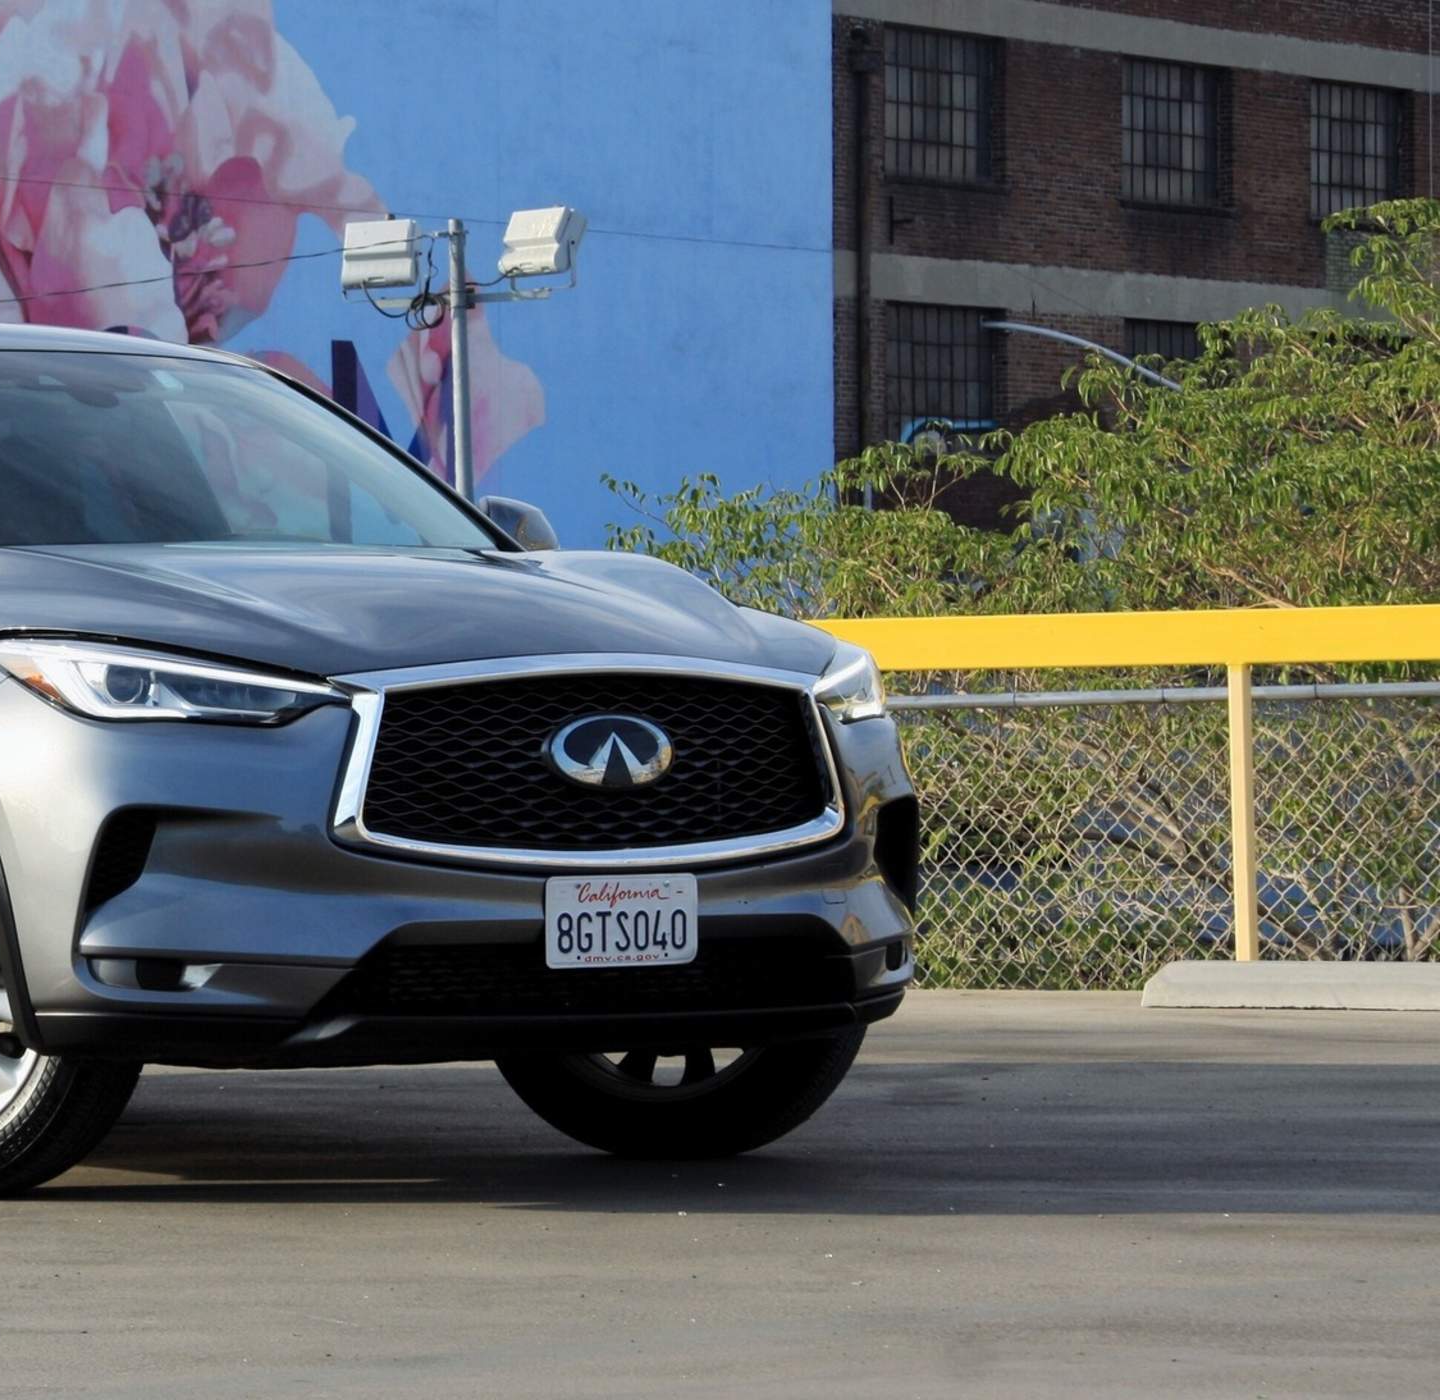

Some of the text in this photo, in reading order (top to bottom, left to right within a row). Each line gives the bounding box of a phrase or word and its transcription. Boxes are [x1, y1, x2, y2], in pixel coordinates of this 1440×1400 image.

[577, 882, 670, 908] California
[558, 909, 686, 954] 8GTS040
[584, 953, 660, 963] dmv.ca.gov
